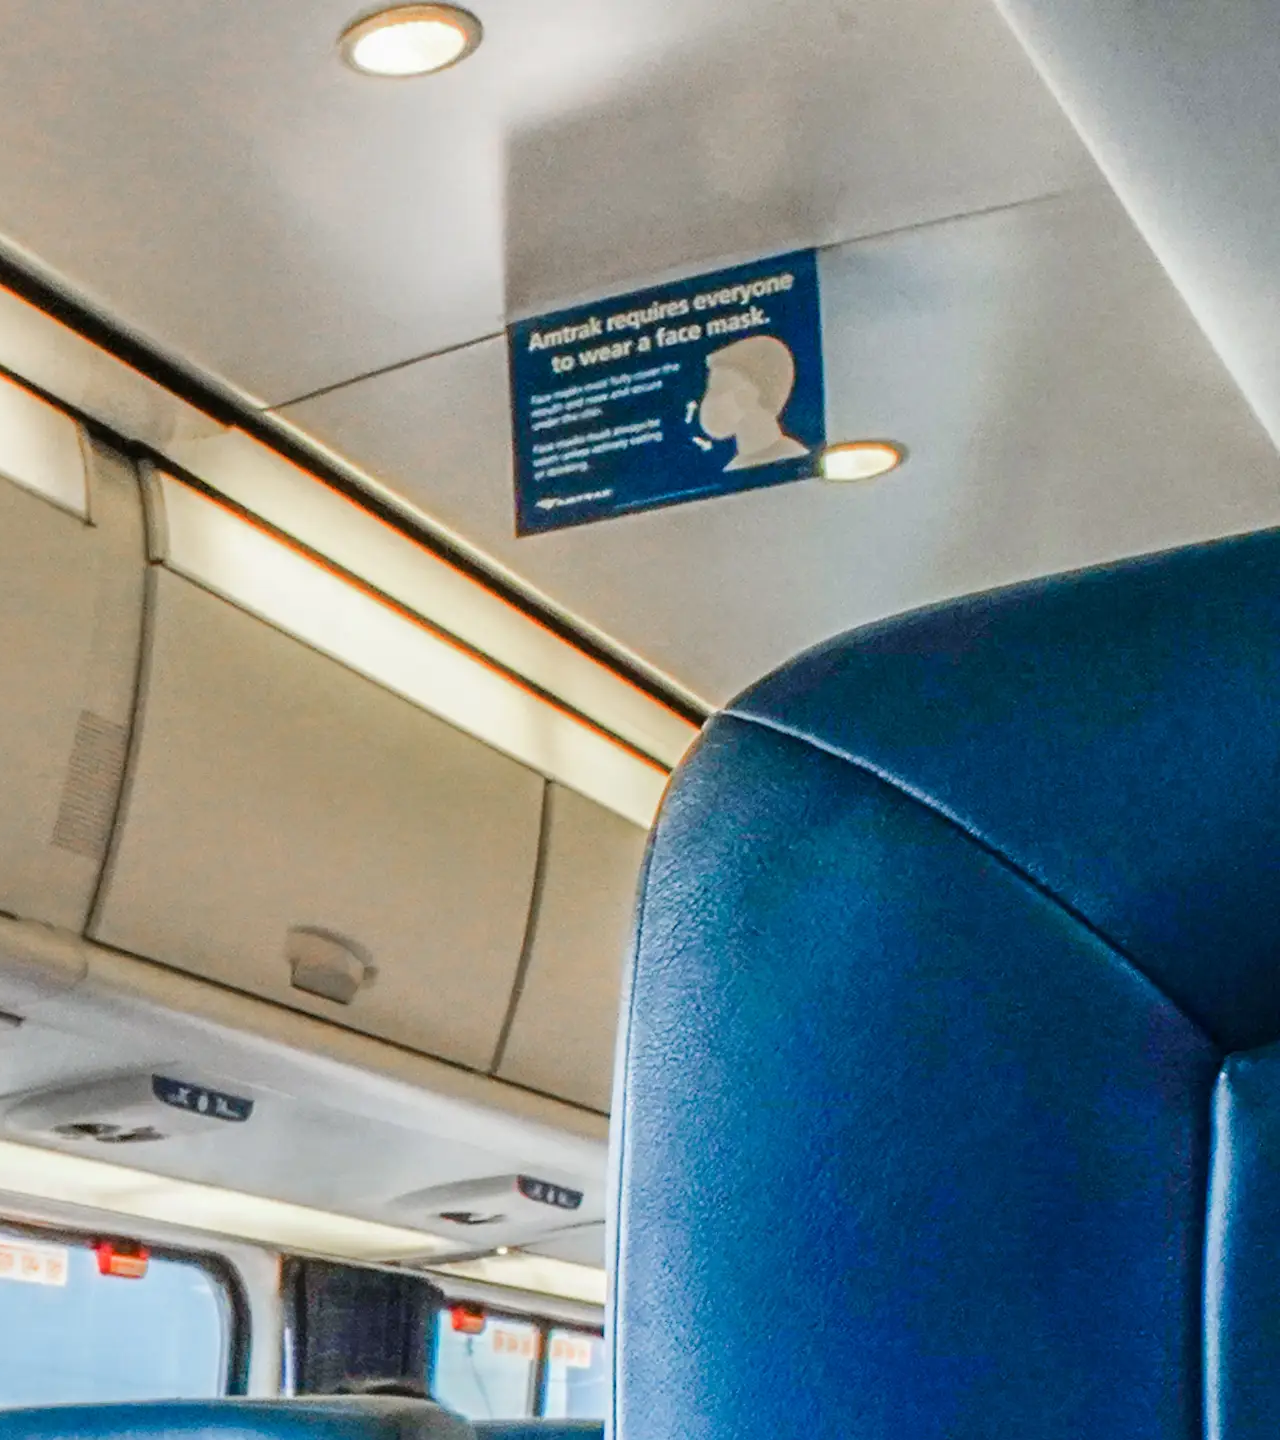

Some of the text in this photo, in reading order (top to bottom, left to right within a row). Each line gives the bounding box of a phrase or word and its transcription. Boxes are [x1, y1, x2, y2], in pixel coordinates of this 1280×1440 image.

[528, 273, 794, 351] Amtrak requires everyone
[551, 306, 770, 373] to wear a face mask.
